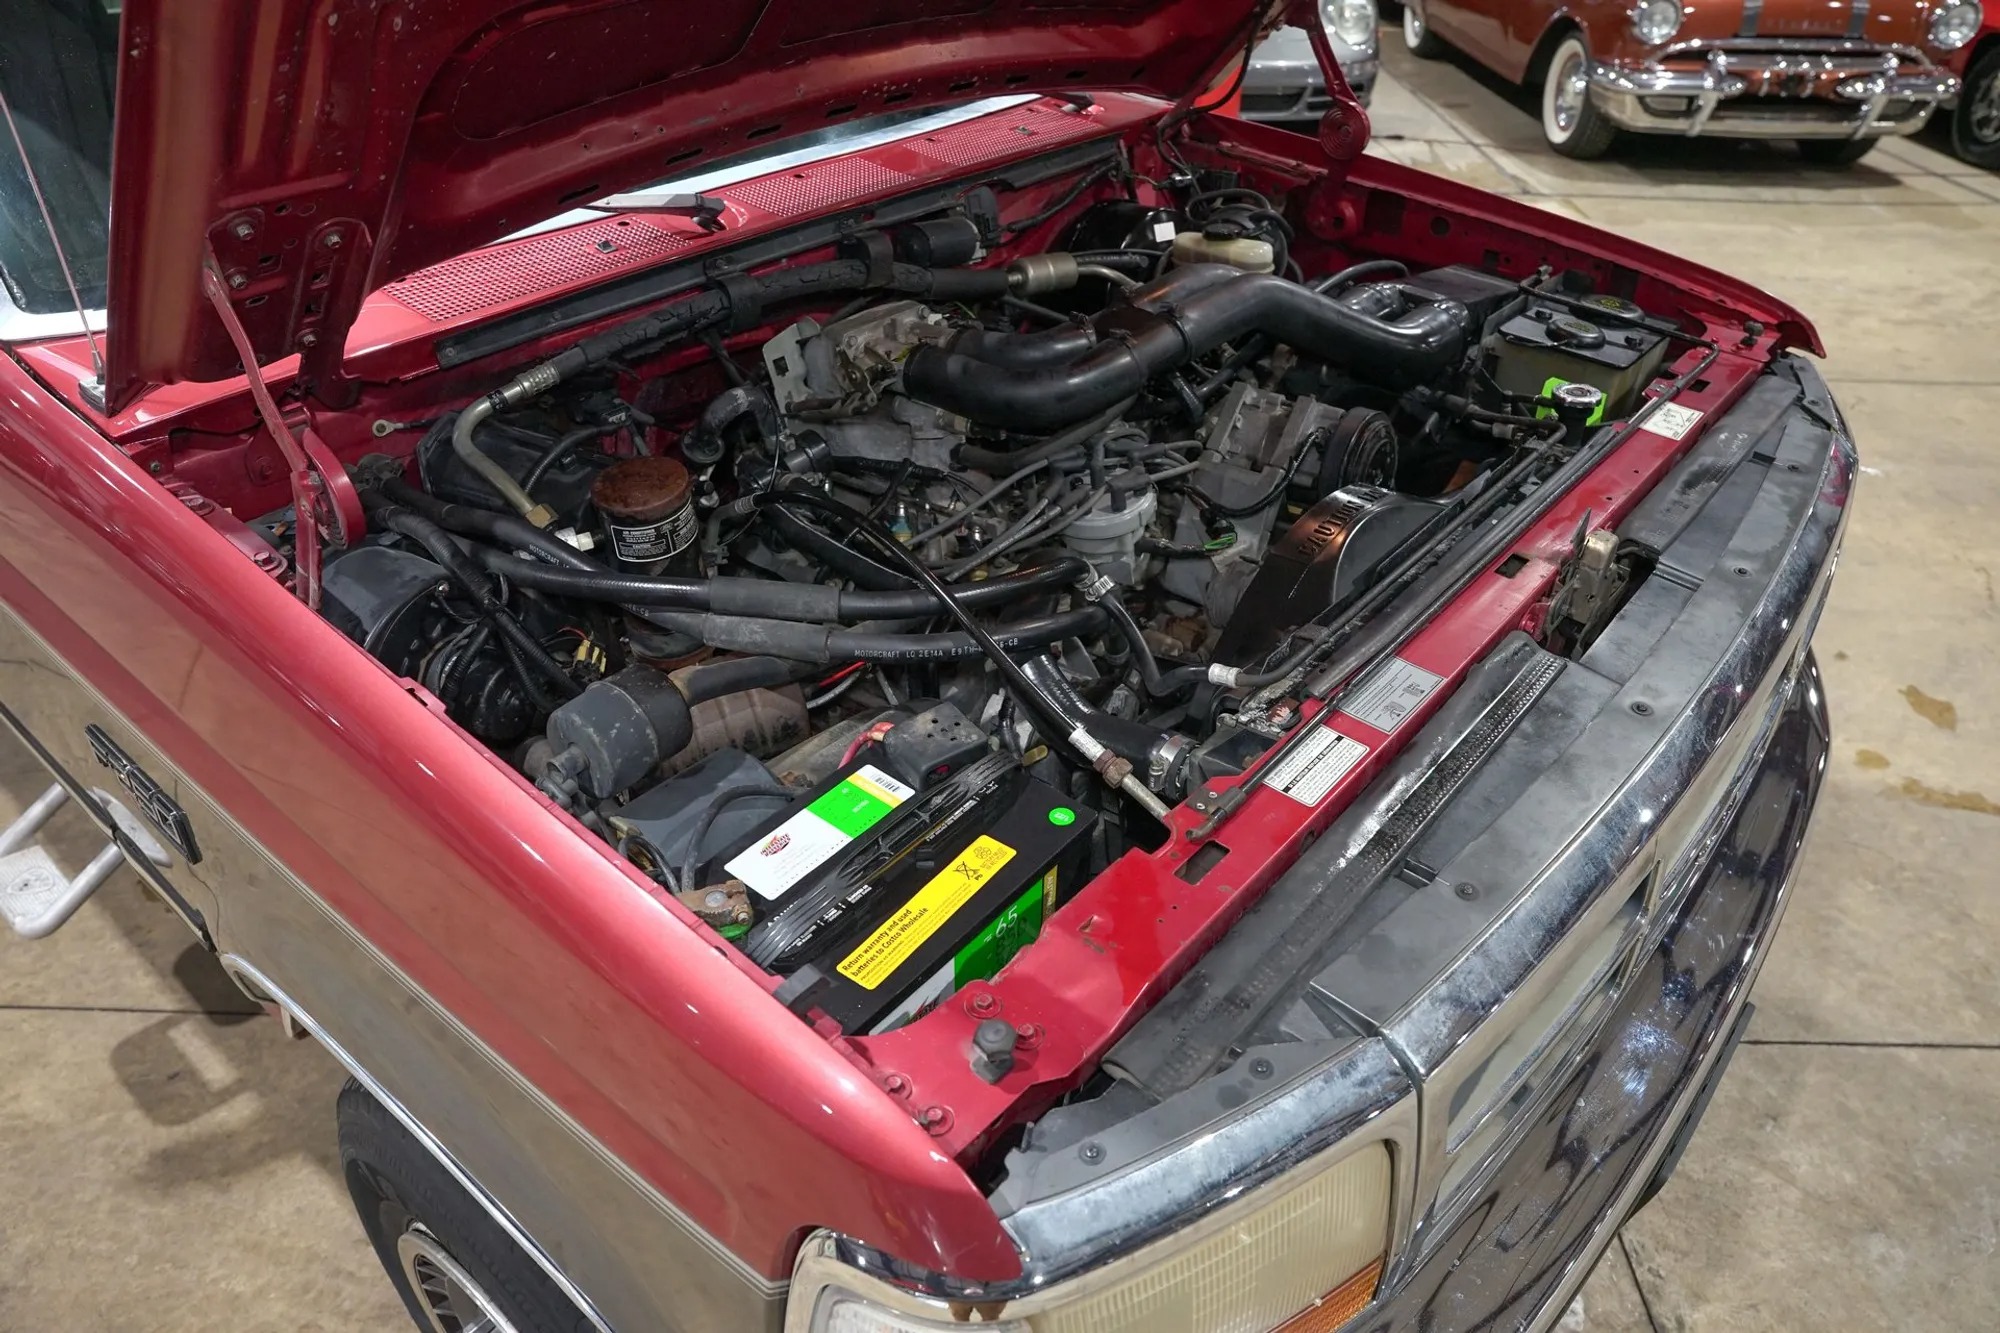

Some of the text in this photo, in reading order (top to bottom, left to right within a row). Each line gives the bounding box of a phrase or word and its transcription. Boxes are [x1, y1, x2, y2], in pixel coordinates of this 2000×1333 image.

[854, 649, 900, 658] MOTORCRAFT
[842, 908, 912, 972] Return warranty and used
[851, 907, 929, 977] batteries to Costco Wholesale
[995, 905, 1018, 938] 65
